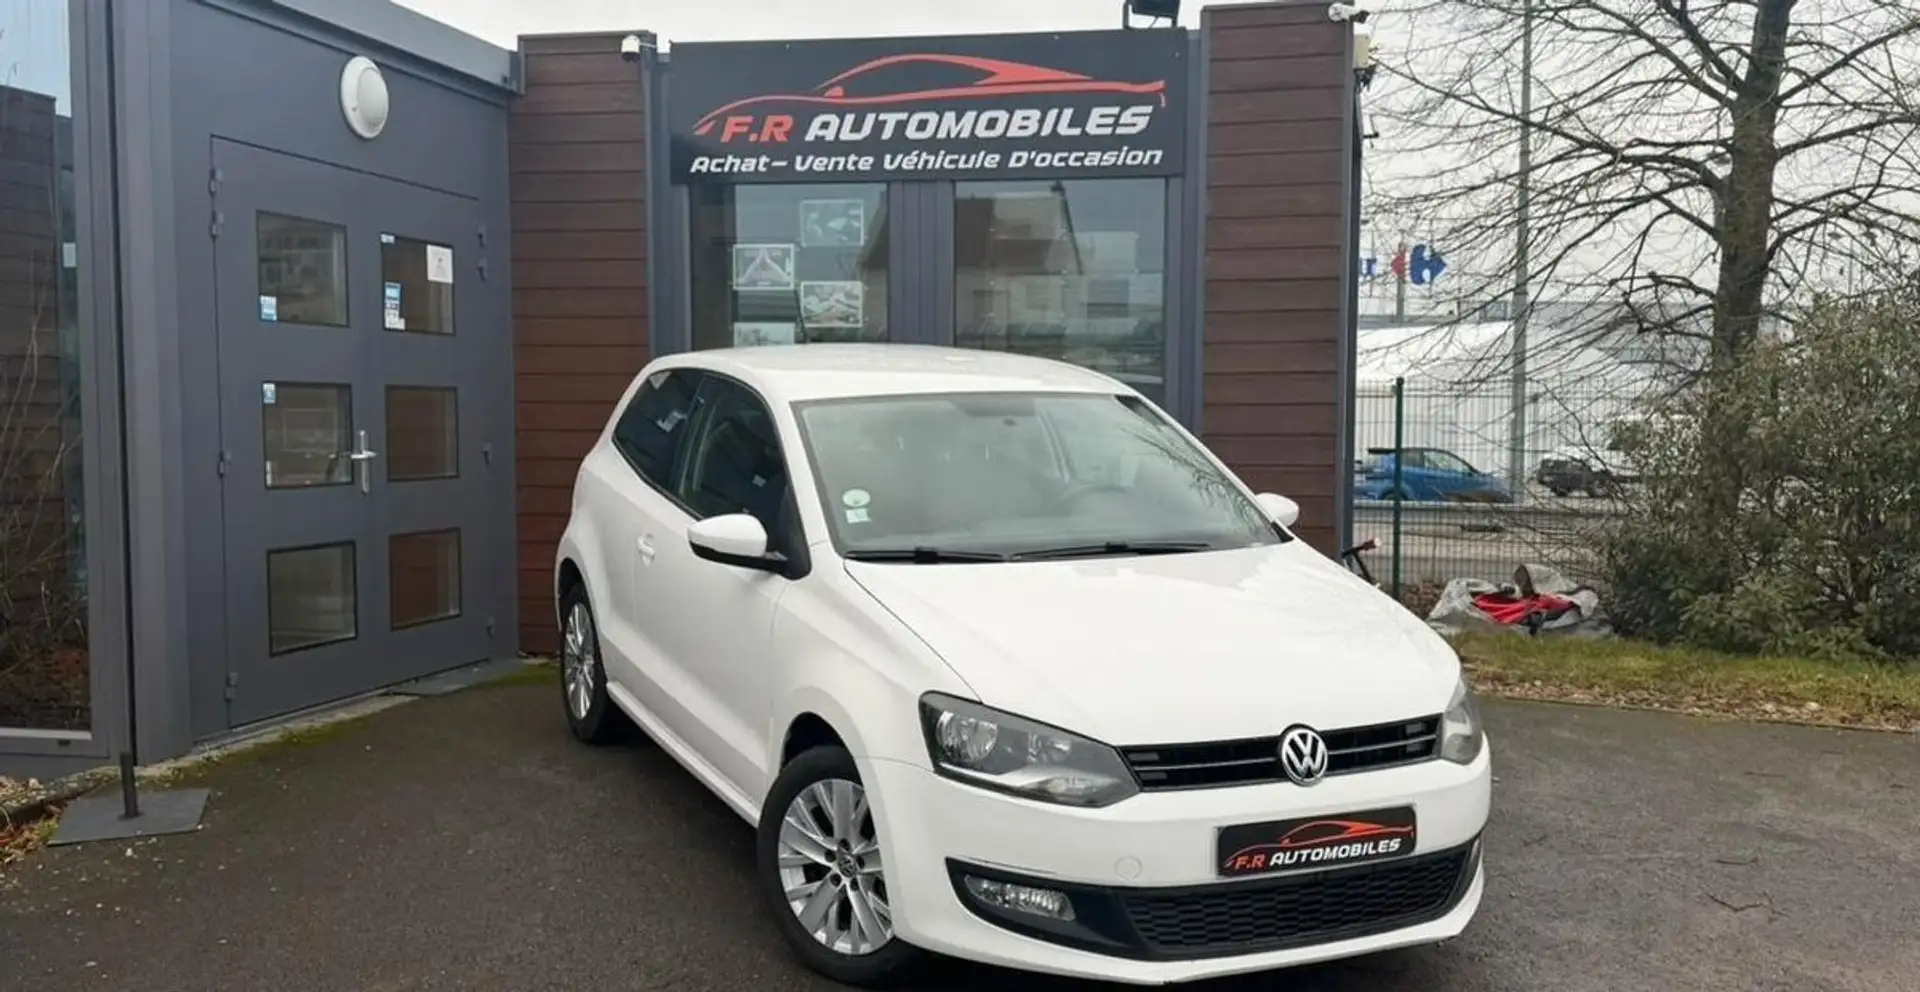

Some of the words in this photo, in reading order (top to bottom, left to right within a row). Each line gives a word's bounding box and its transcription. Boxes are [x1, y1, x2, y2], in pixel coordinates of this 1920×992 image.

[720, 114, 794, 143] F.R
[804, 105, 1154, 142] AUTOMOBILES
[794, 153, 875, 172] Vente
[883, 148, 1002, 171] Véhicule
[1007, 146, 1163, 169] D'occasion
[1234, 852, 1266, 871] F.R
[1269, 838, 1402, 867] AUTOMOBILES
